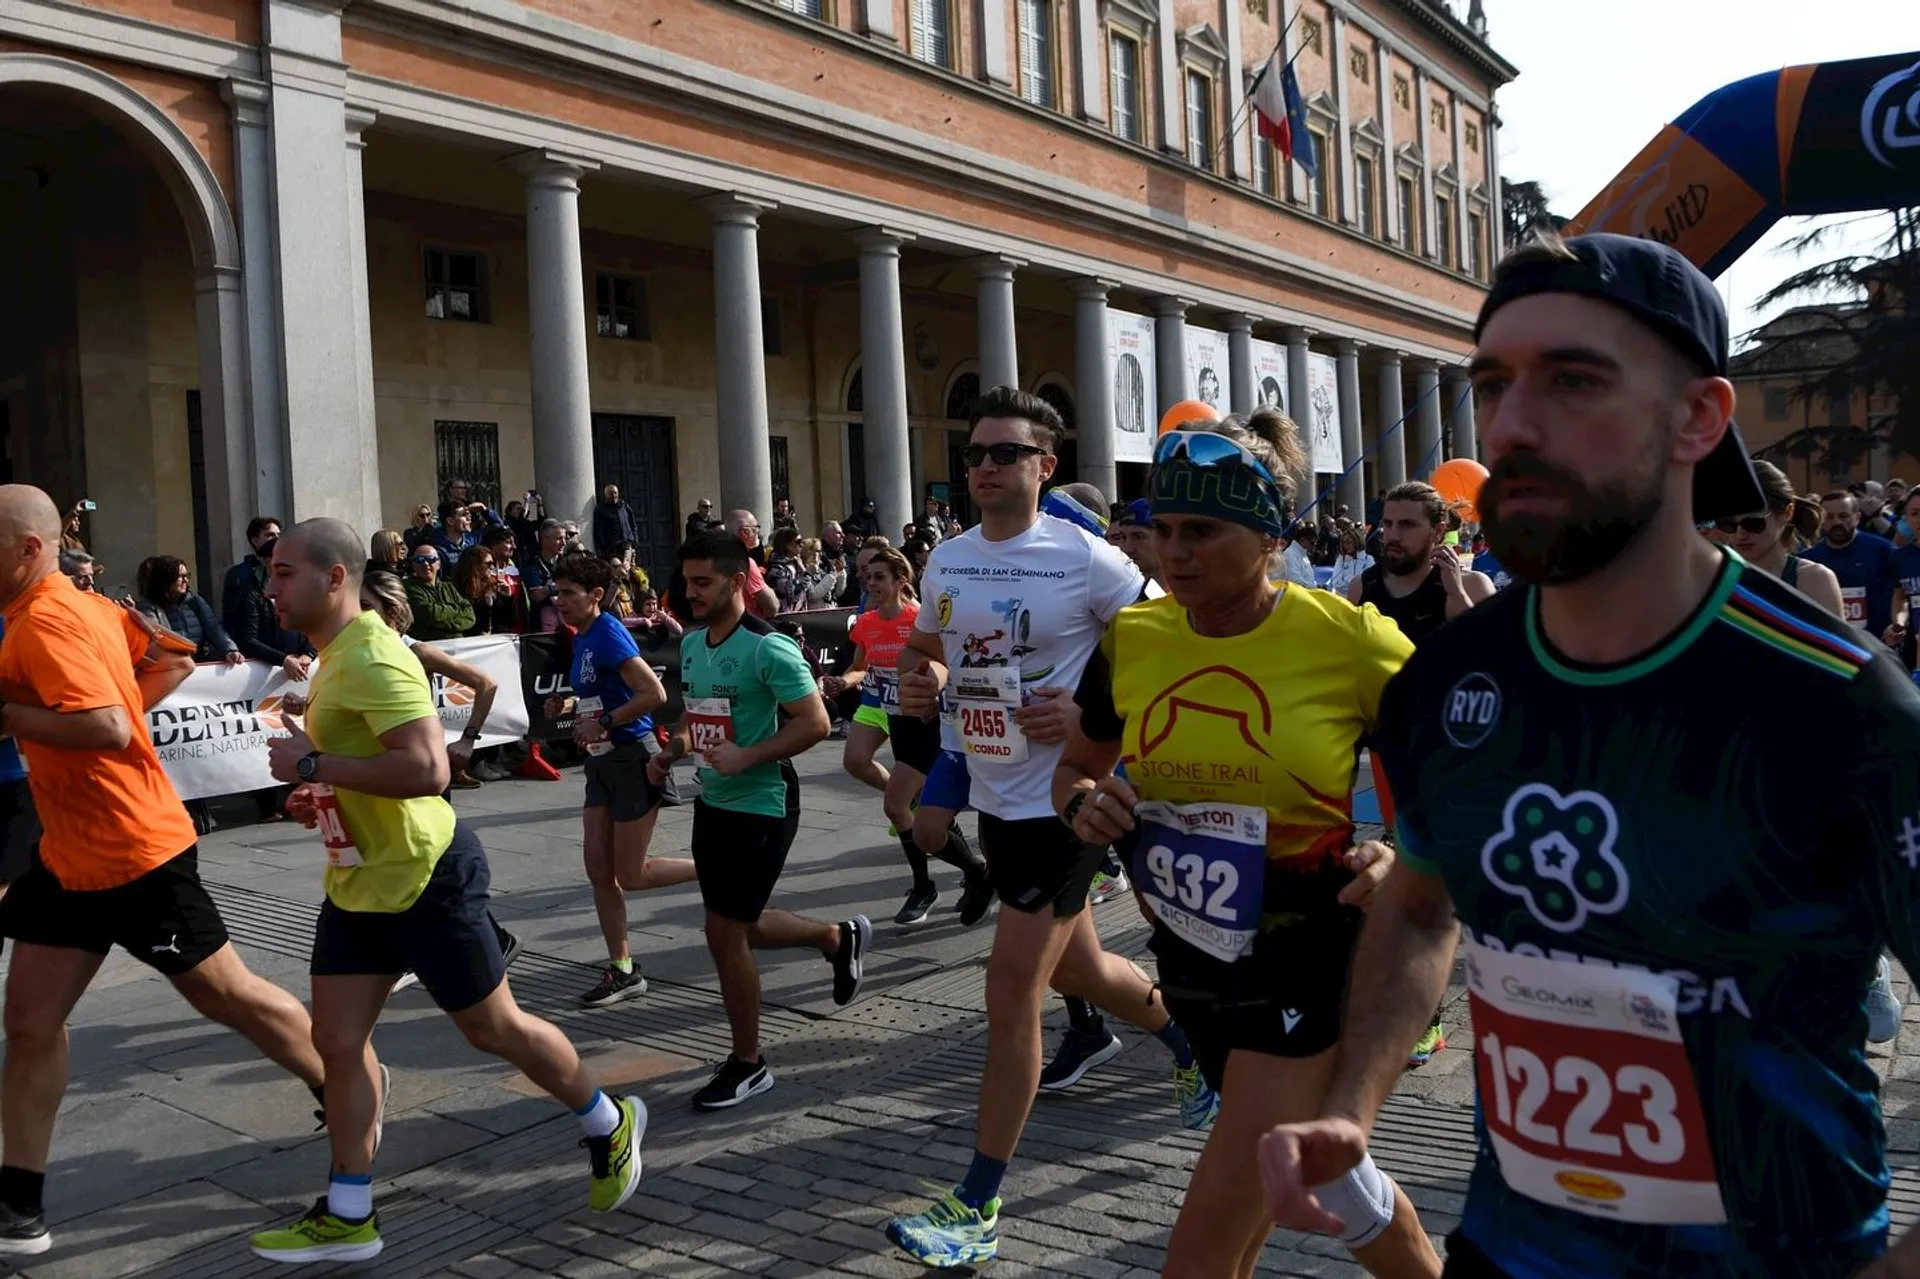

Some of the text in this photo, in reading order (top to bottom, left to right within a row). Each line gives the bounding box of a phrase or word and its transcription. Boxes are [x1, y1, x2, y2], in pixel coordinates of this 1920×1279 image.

[992, 568, 1008, 576] SAN
[1011, 569, 1065, 579] GEMINIANO
[1450, 690, 1496, 724] RYD
[961, 708, 1006, 738] 2455
[973, 744, 1012, 756] CONAD
[1141, 760, 1263, 785] STONE TRAIL
[1147, 844, 1239, 922] 932
[1481, 1032, 1686, 1164] 1223
